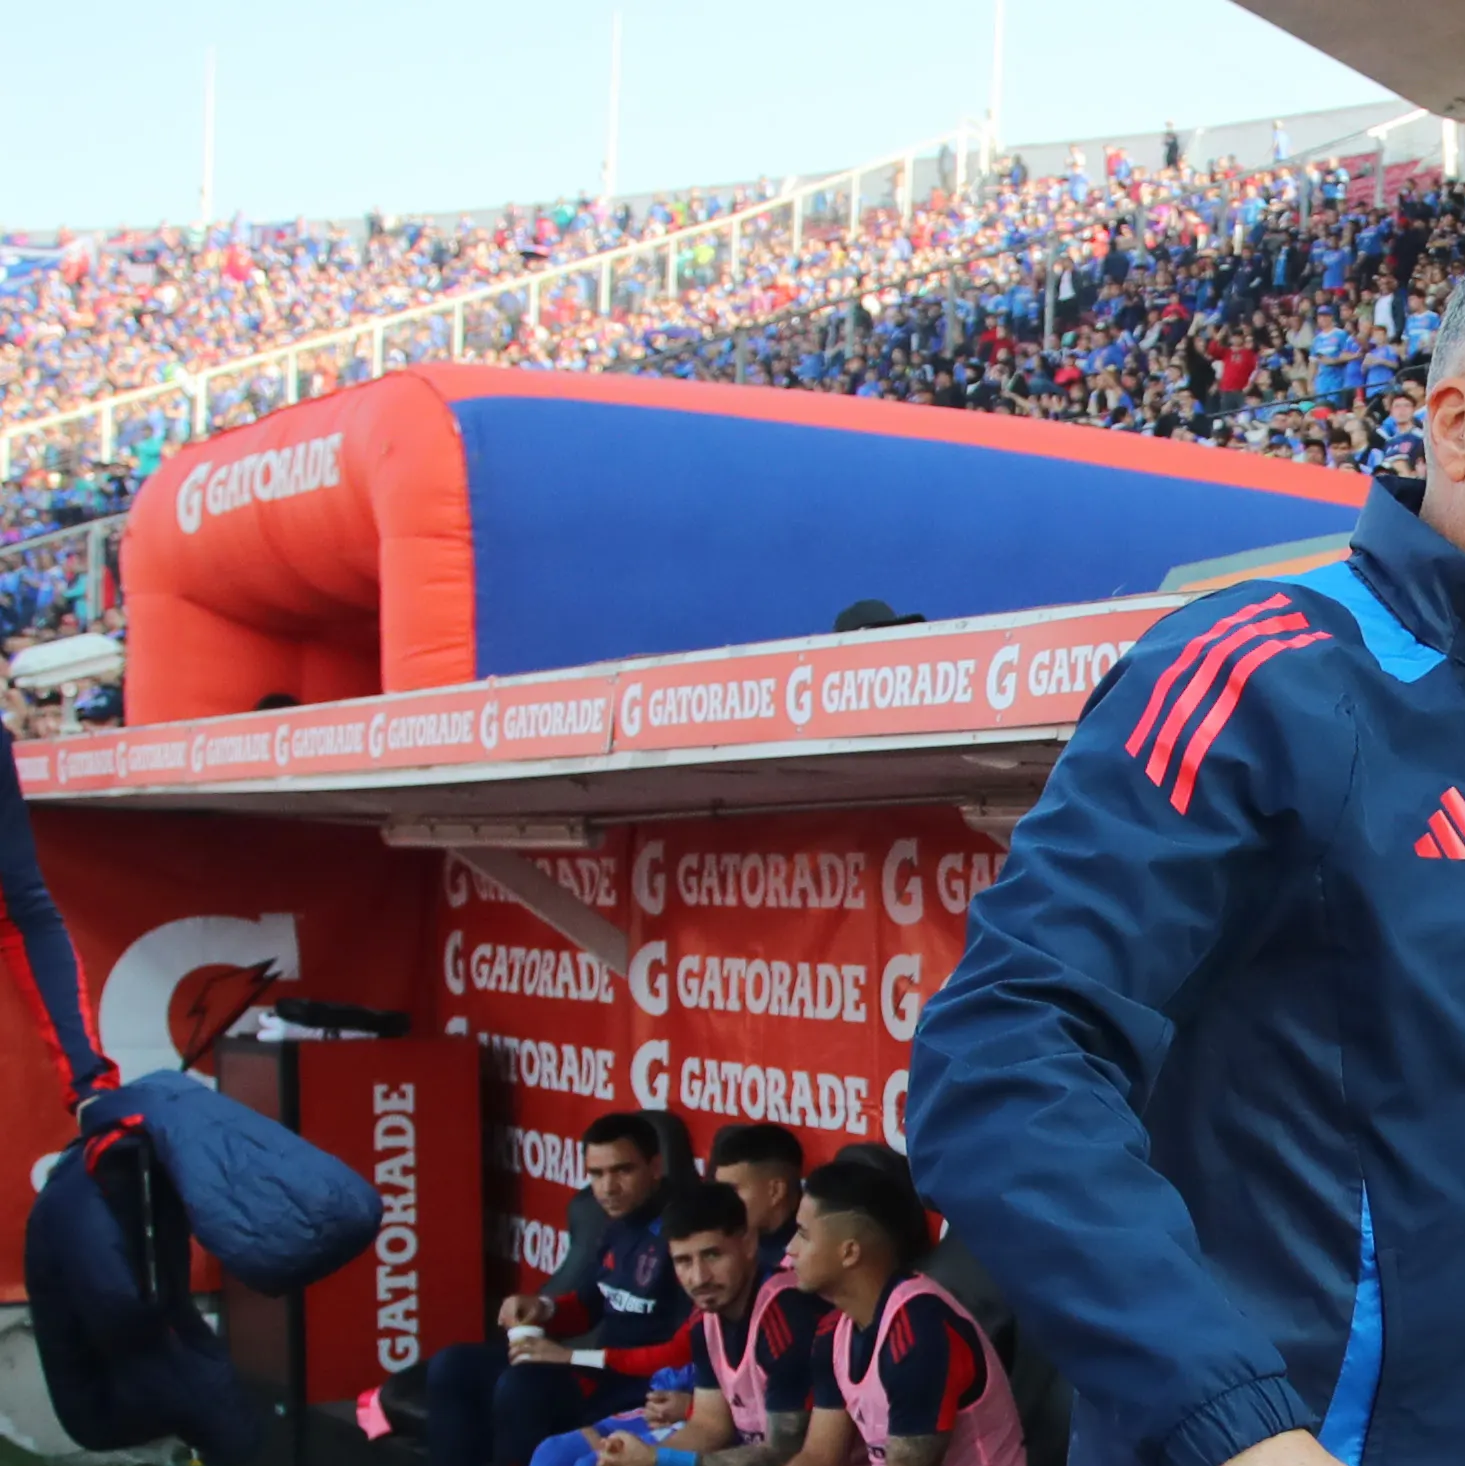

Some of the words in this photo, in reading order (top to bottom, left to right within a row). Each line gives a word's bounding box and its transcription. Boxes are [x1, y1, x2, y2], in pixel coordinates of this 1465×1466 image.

[207, 431, 344, 516] GATORADE
[387, 711, 475, 750] GATORADE
[480, 700, 498, 750] G
[503, 696, 608, 741] GATORADE
[621, 682, 643, 737] G
[648, 678, 776, 723] GATORADE
[786, 665, 812, 726] G
[822, 659, 976, 714] GATORADE
[986, 644, 1020, 710] G
[632, 840, 666, 915] G
[676, 852, 866, 910] GATORADE
[882, 838, 923, 925] G
[628, 941, 668, 1016] G
[676, 954, 867, 1023] GATORADE
[880, 954, 921, 1041] G
[680, 1056, 868, 1136] GATORADE
[373, 1082, 418, 1373] GATORADE
